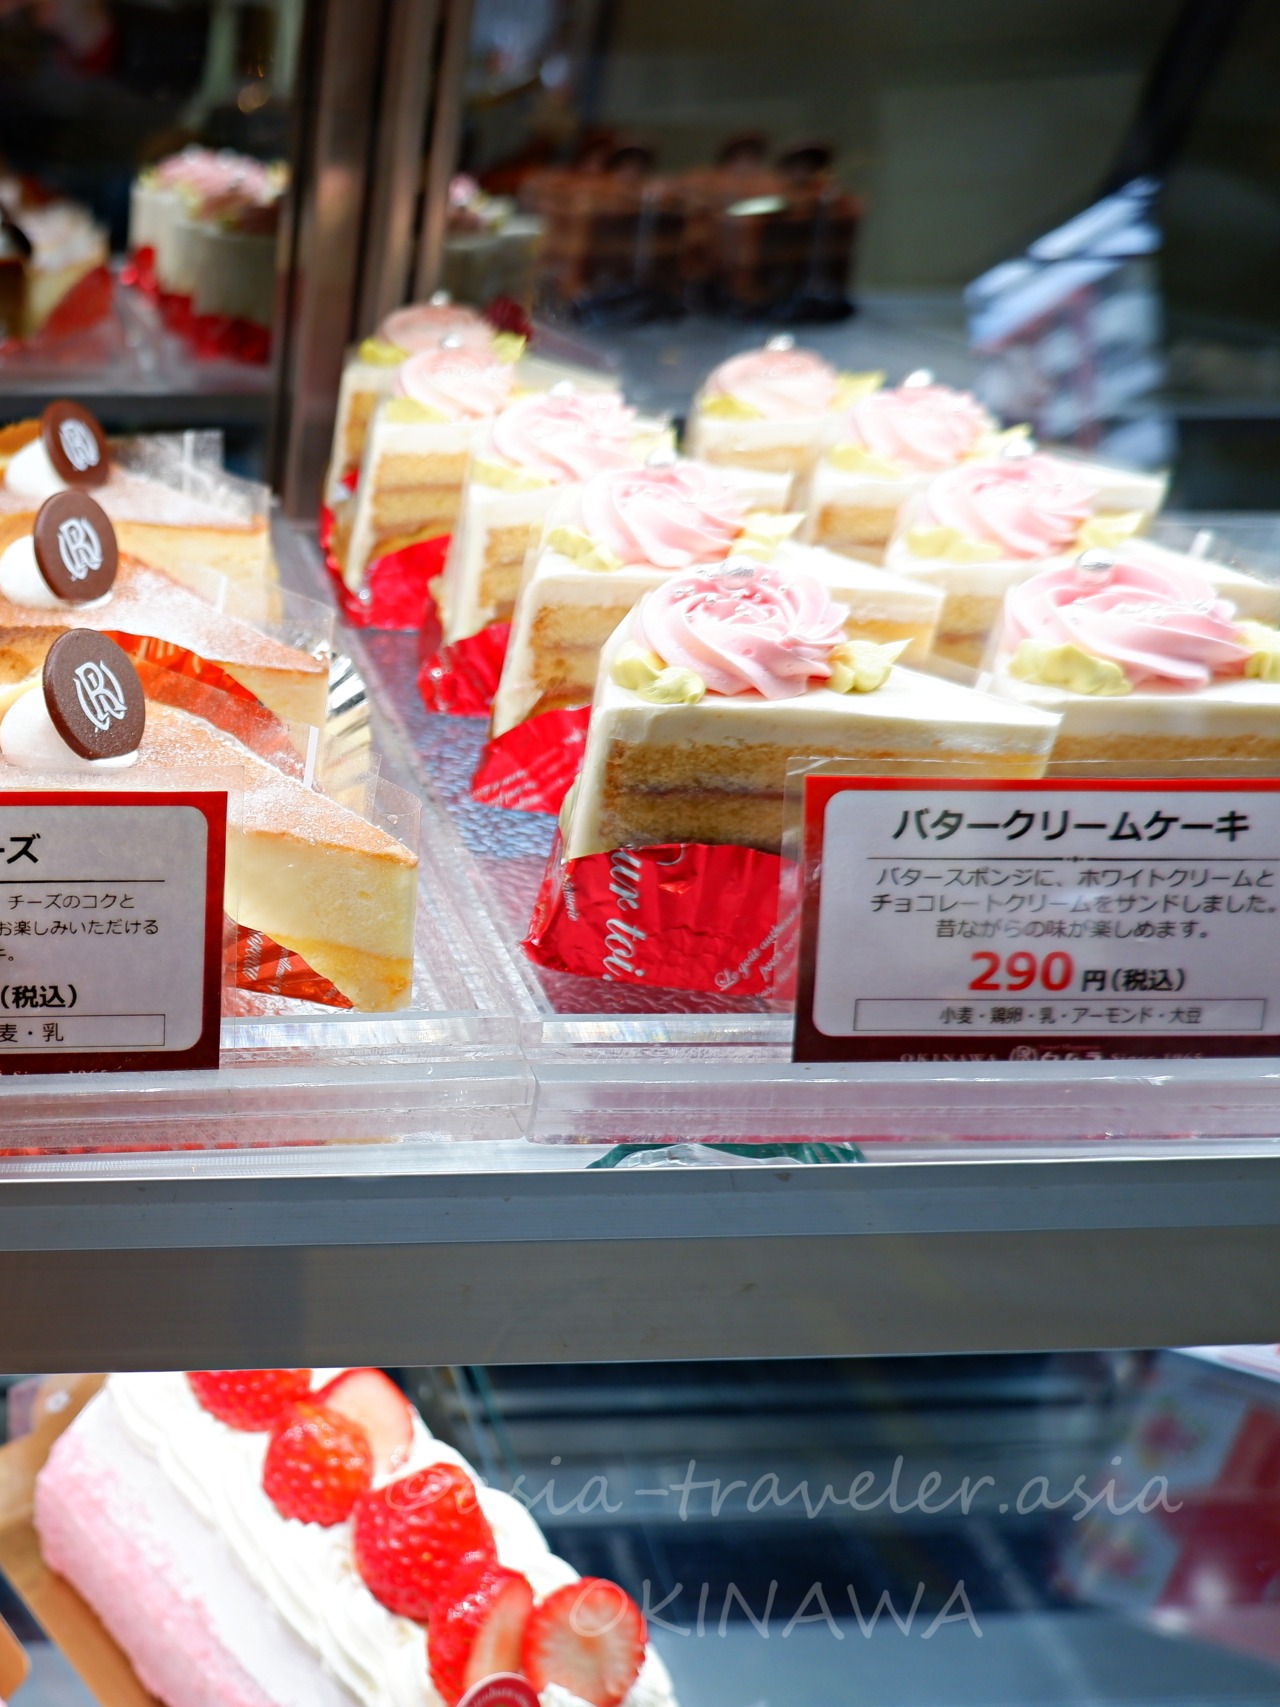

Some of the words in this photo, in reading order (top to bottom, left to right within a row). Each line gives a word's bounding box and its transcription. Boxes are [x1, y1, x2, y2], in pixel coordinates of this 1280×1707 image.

[892, 808, 1250, 843] バタークリームケーキ
[875, 866, 1275, 888] バタースポンジに、ホワイトクリームと
[870, 893, 1277, 914] チョコレートクリームをサンドしました。
[935, 919, 1209, 939] 昔ながらの味が楽しめます。
[968, 950, 1075, 992] 290
